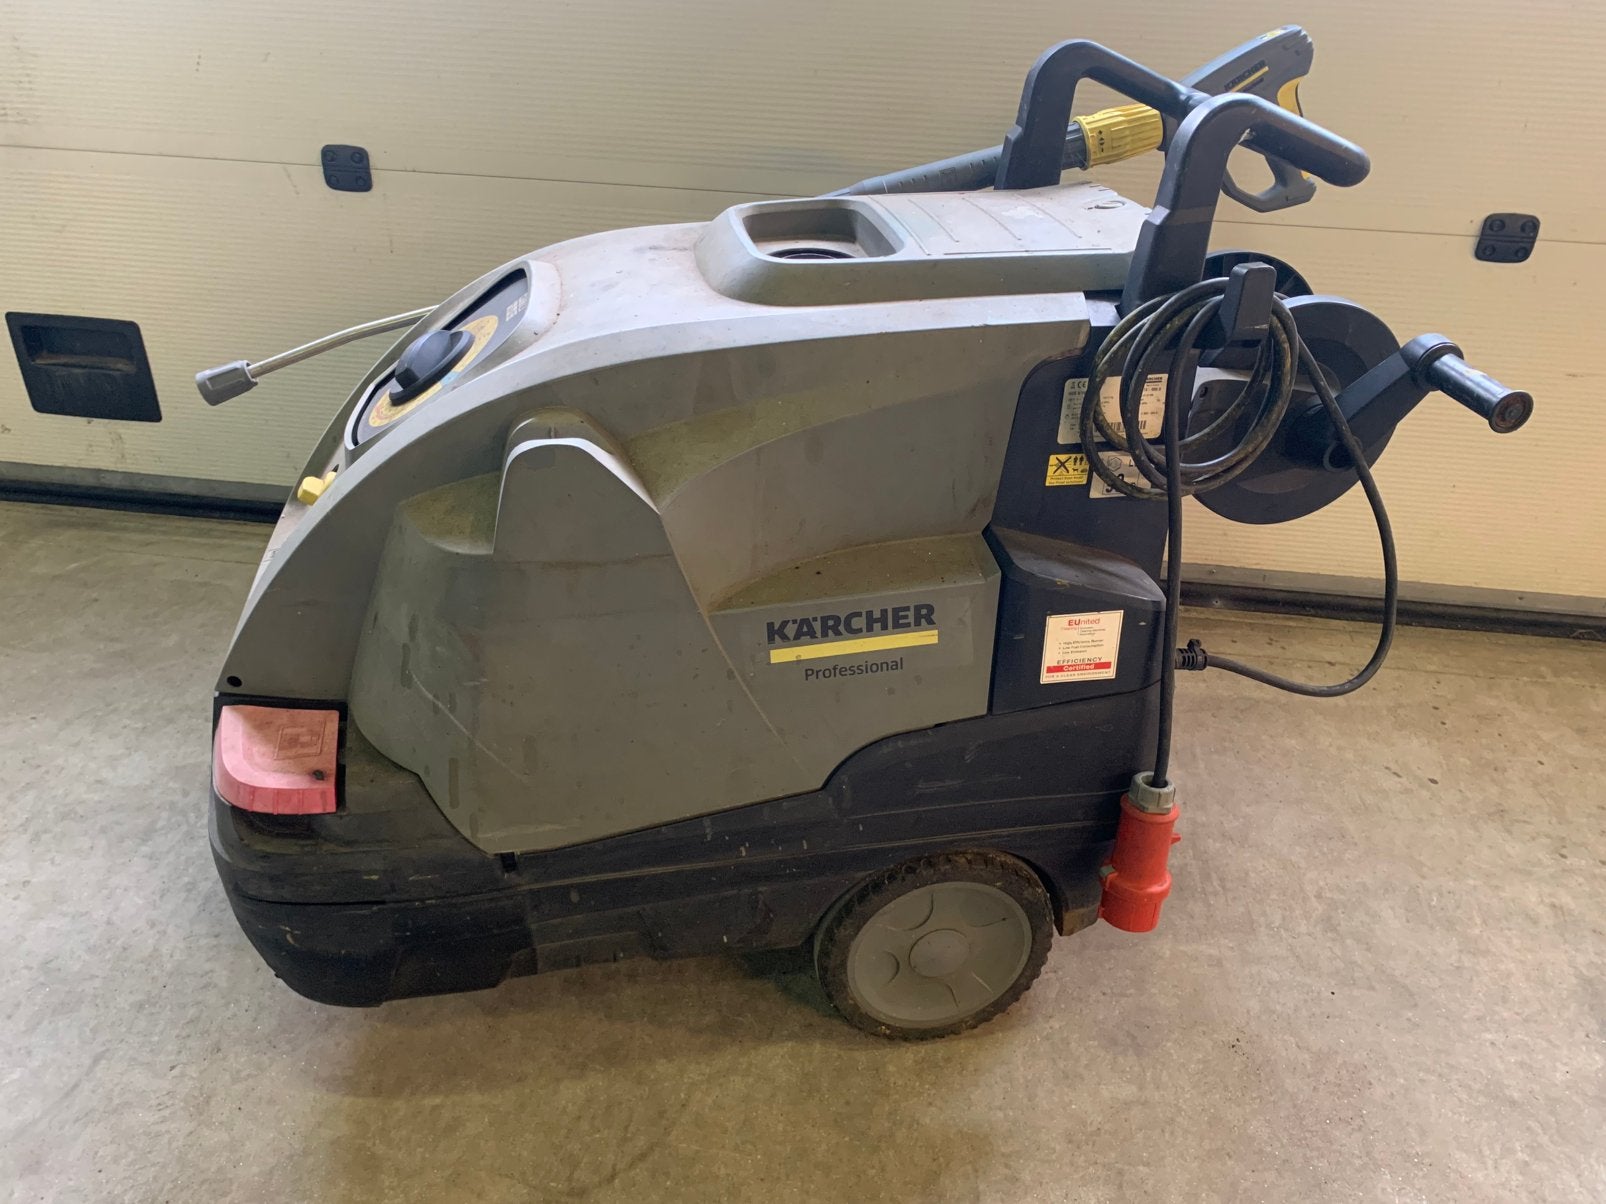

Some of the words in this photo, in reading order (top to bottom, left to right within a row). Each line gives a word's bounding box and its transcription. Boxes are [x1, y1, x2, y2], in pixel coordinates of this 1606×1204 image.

[766, 603, 936, 645] KÄRCHER
[1068, 617, 1101, 627] EUnited
[1056, 656, 1103, 665] EFFICIENCY
[804, 657, 904, 681] Professional
[1063, 663, 1095, 671] Certified
